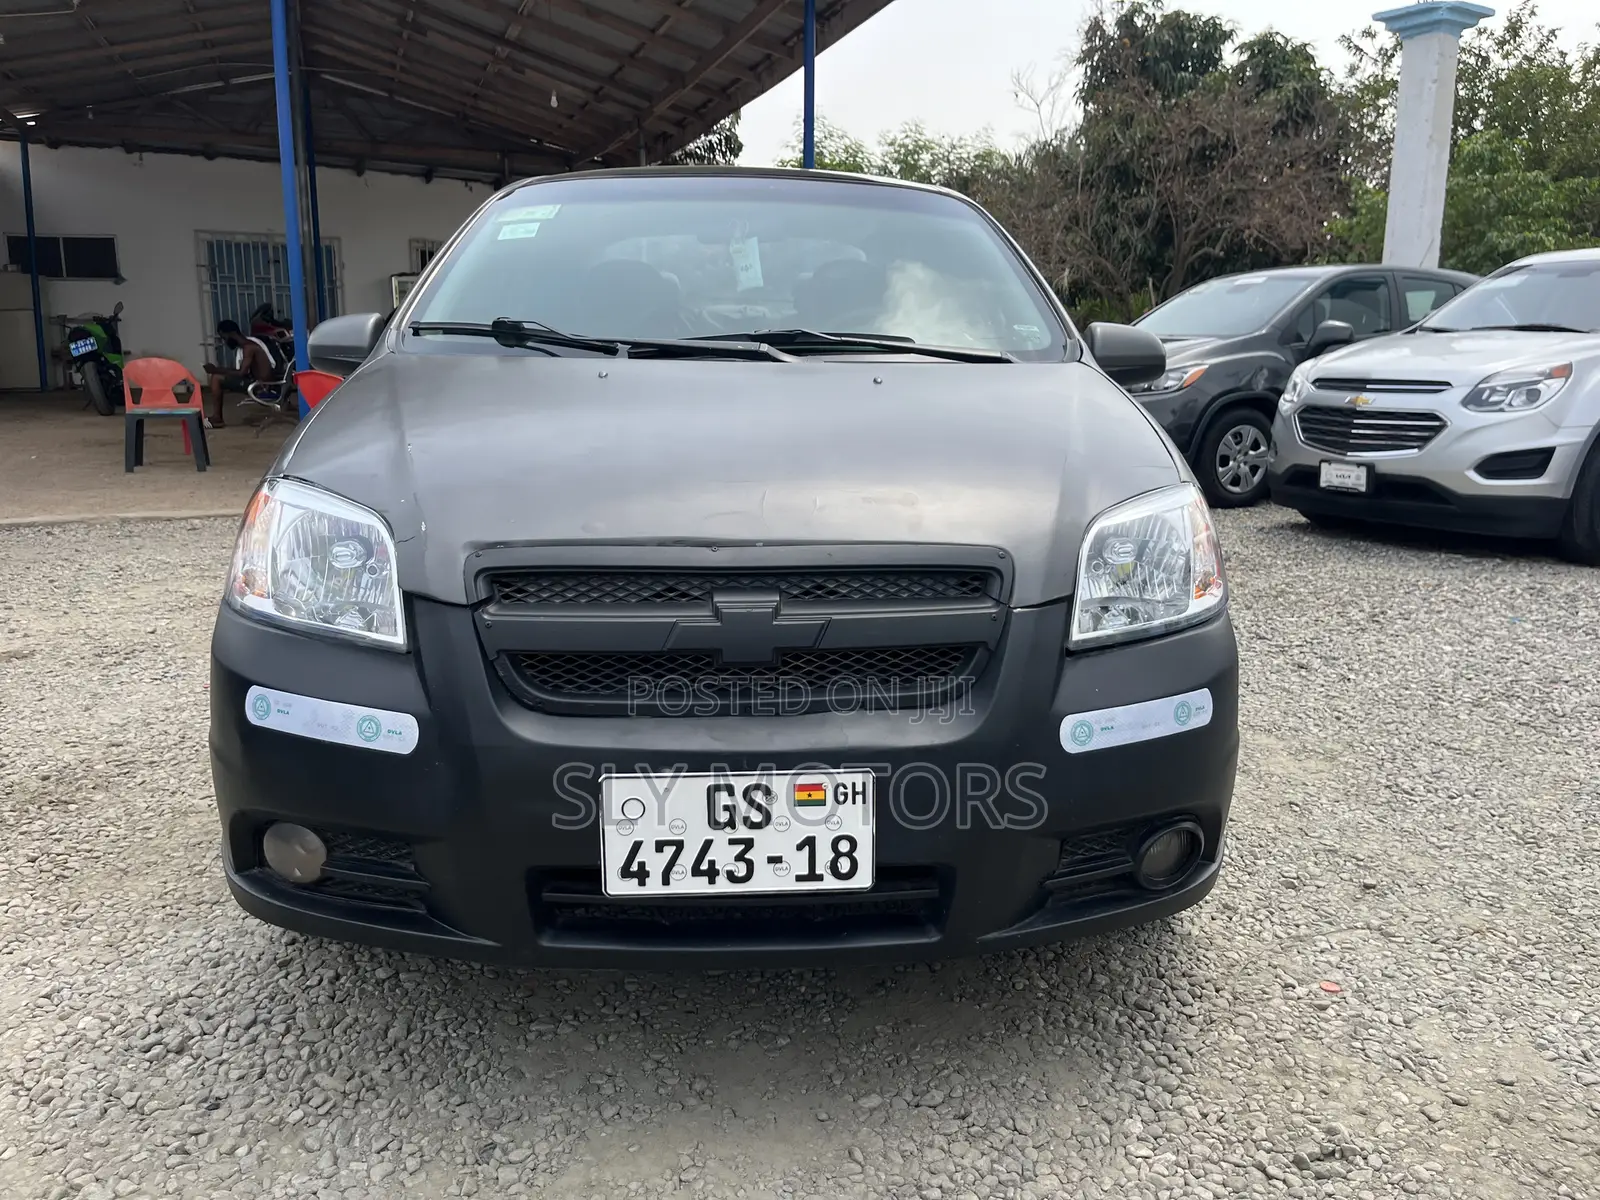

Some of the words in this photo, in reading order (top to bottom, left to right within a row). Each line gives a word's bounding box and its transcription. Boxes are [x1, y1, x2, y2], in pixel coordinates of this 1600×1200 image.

[276, 708, 290, 716] DVLA
[706, 783, 772, 830] GS
[833, 782, 867, 805] GH
[620, 835, 859, 887] 4743-18
